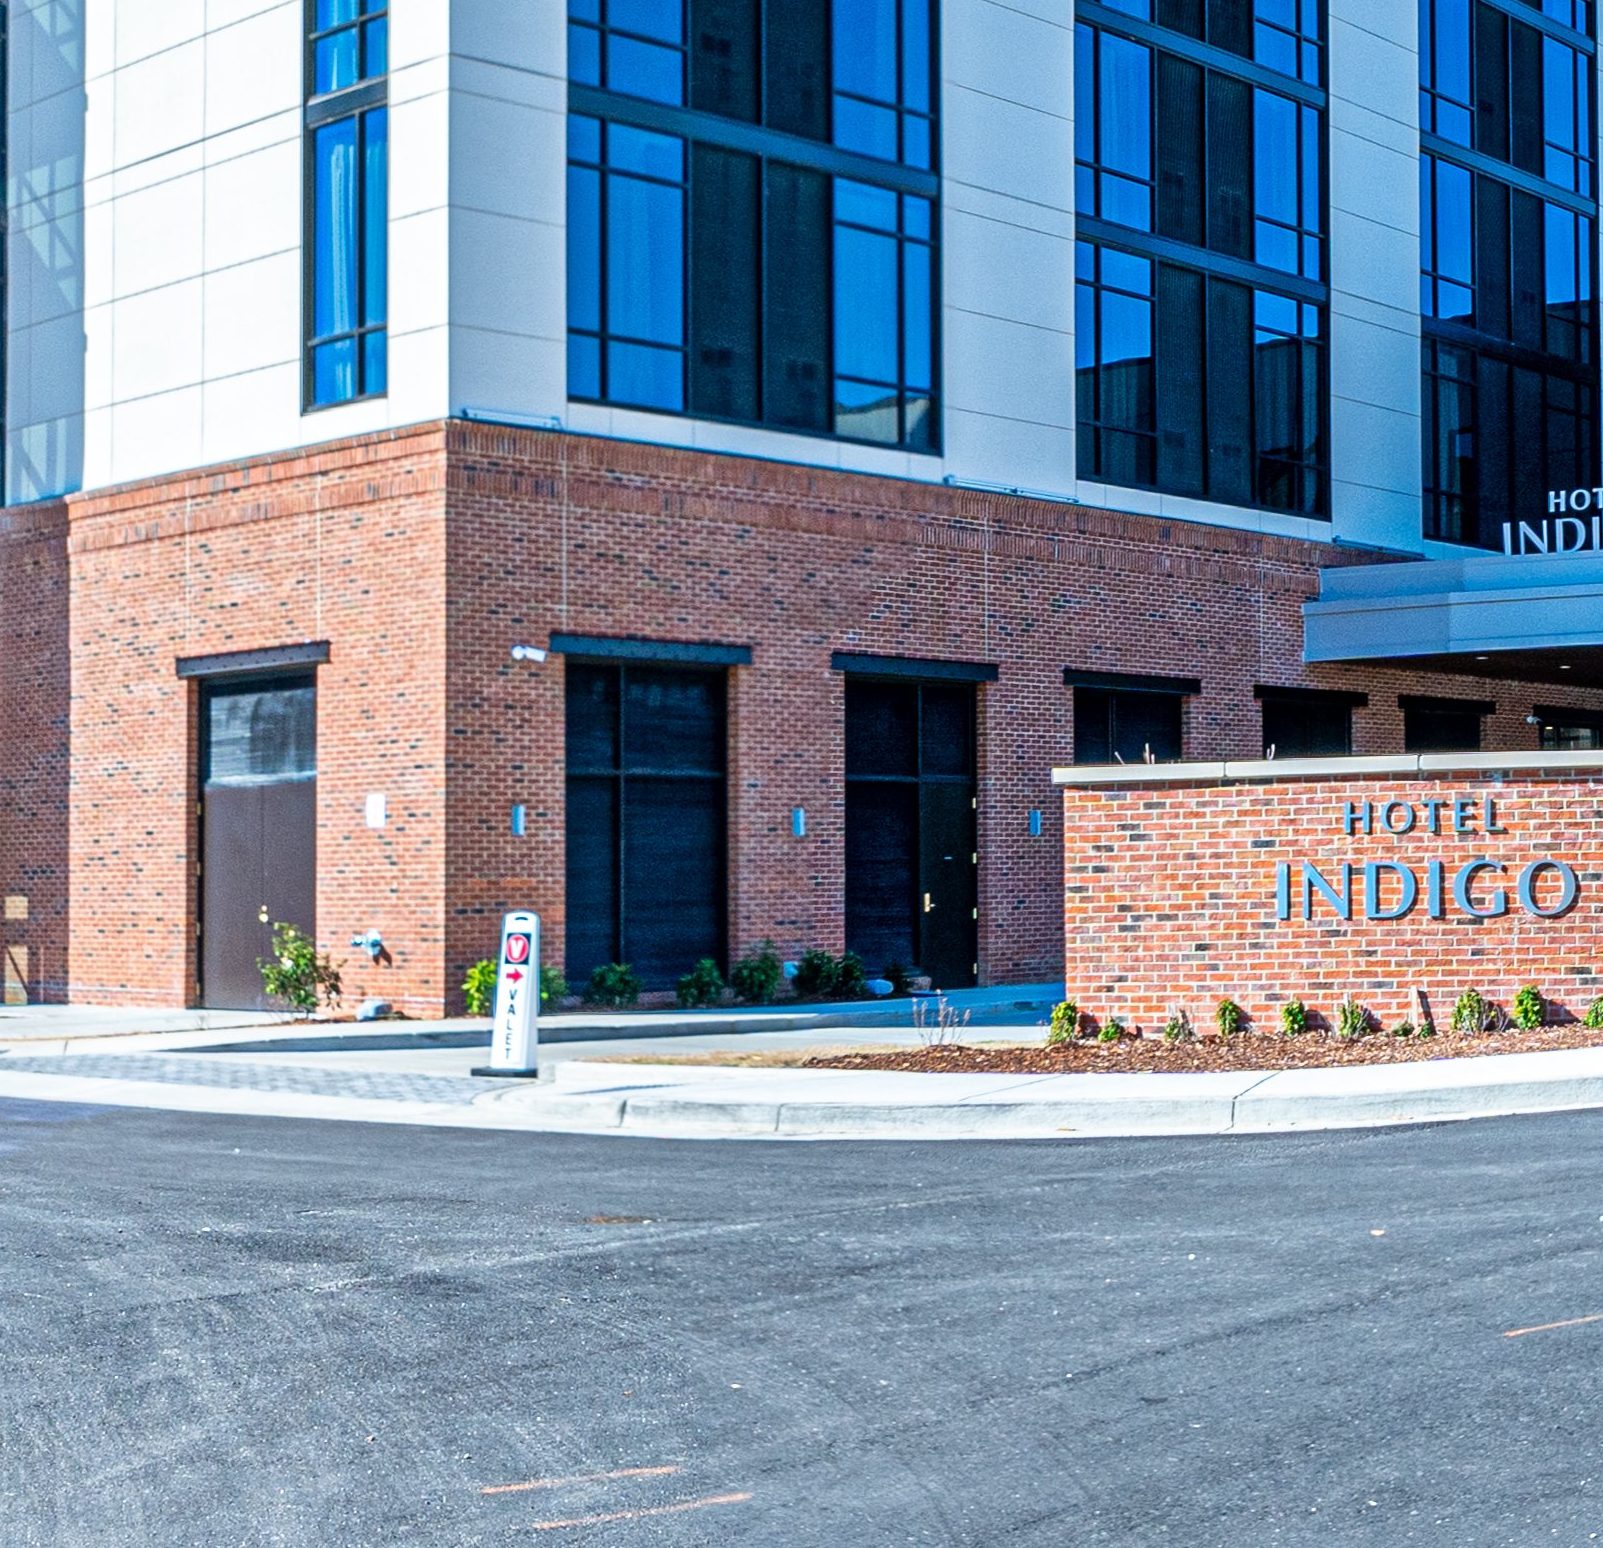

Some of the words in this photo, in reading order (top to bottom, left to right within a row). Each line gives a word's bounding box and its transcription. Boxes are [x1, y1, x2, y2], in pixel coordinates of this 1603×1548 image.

[1343, 798, 1506, 835] HOTEL
[1274, 858, 1579, 920] INDIGO
[505, 989, 518, 1059] VALET
